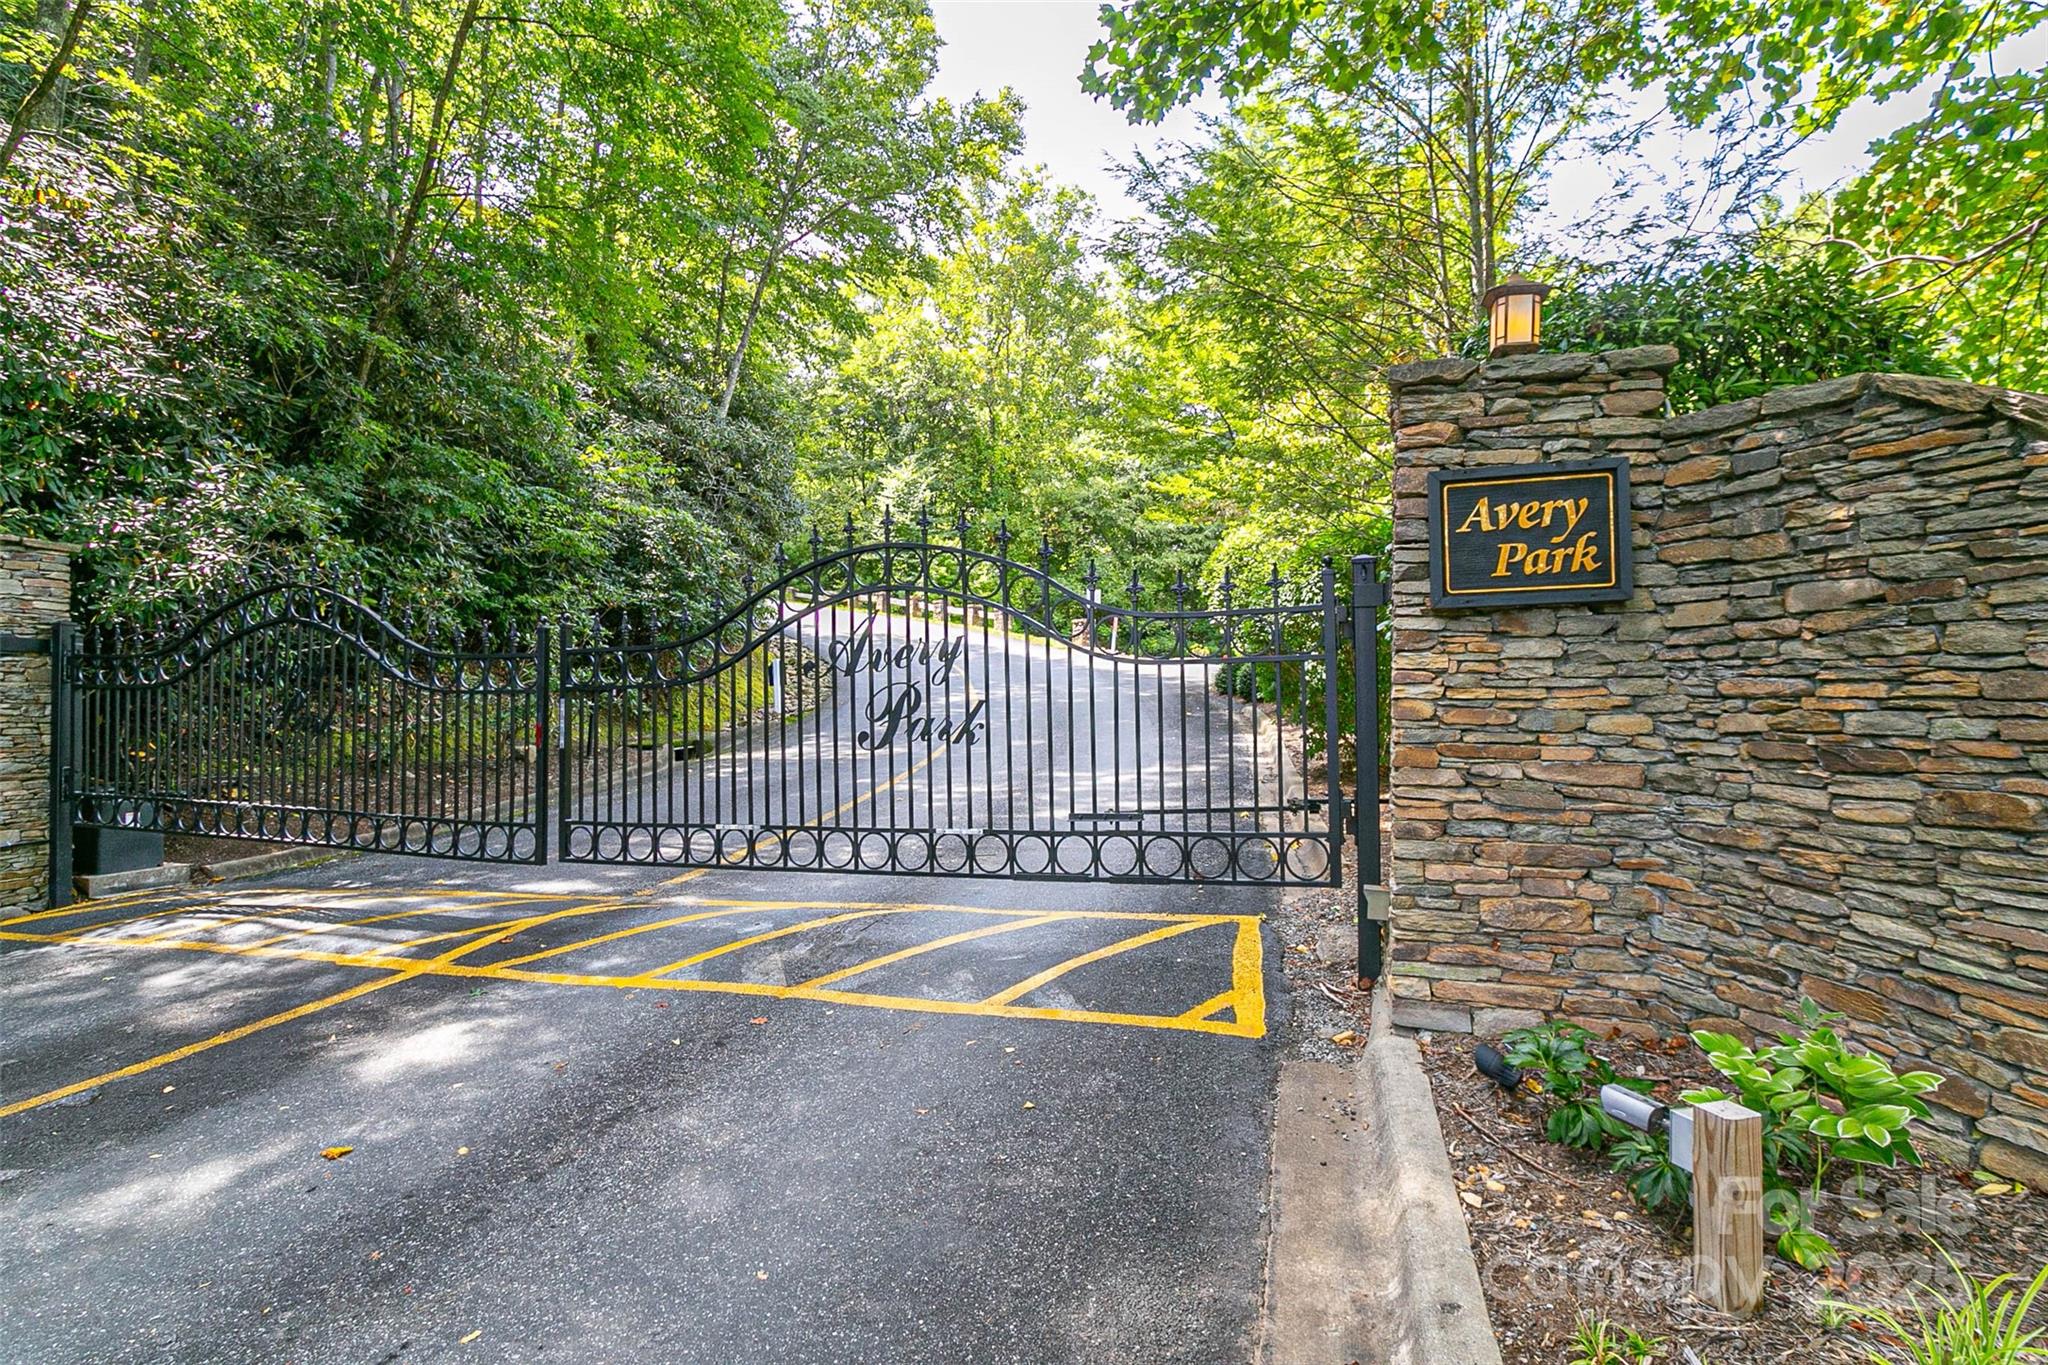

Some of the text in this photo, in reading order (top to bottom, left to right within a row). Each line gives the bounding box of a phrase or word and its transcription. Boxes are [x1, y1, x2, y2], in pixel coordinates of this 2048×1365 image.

[1456, 497, 1588, 543] Avery
[1491, 532, 1602, 577] Park
[803, 609, 964, 686] Avery
[858, 681, 986, 750] Park
